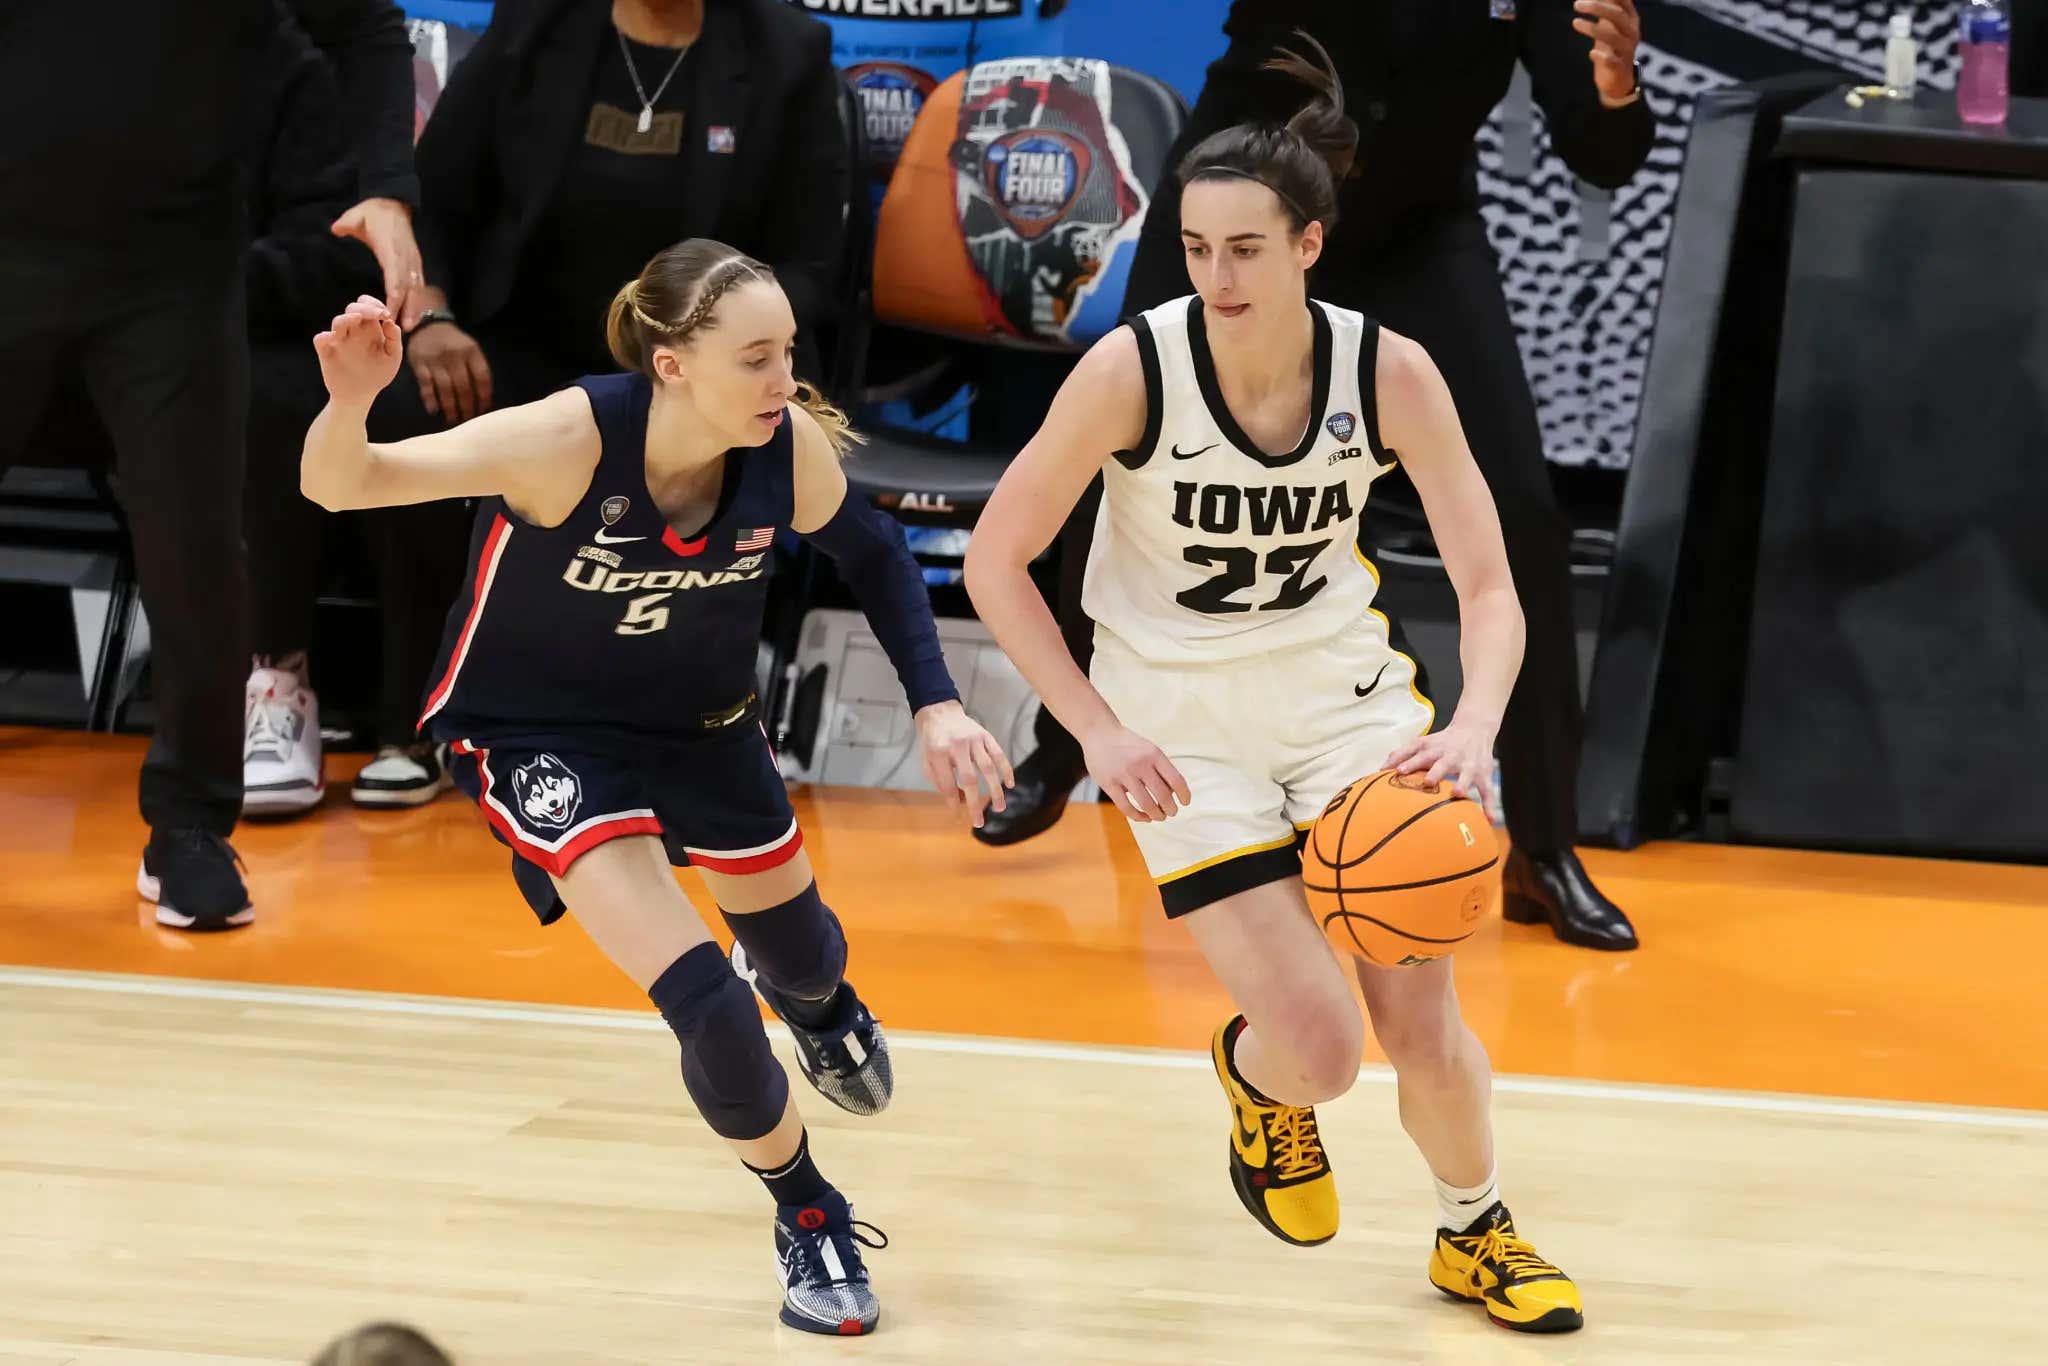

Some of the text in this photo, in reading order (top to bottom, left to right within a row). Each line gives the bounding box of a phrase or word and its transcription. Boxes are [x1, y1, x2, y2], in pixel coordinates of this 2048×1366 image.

[787, 0, 1011, 16] WERADE
[865, 113, 913, 140] OUR
[1007, 152, 1066, 177] FINAL
[1004, 177, 1066, 202] FOUR
[1172, 480, 1353, 536] IOWA
[562, 558, 764, 593] UCONN
[1176, 538, 1334, 614] 22
[614, 592, 672, 635] 5
